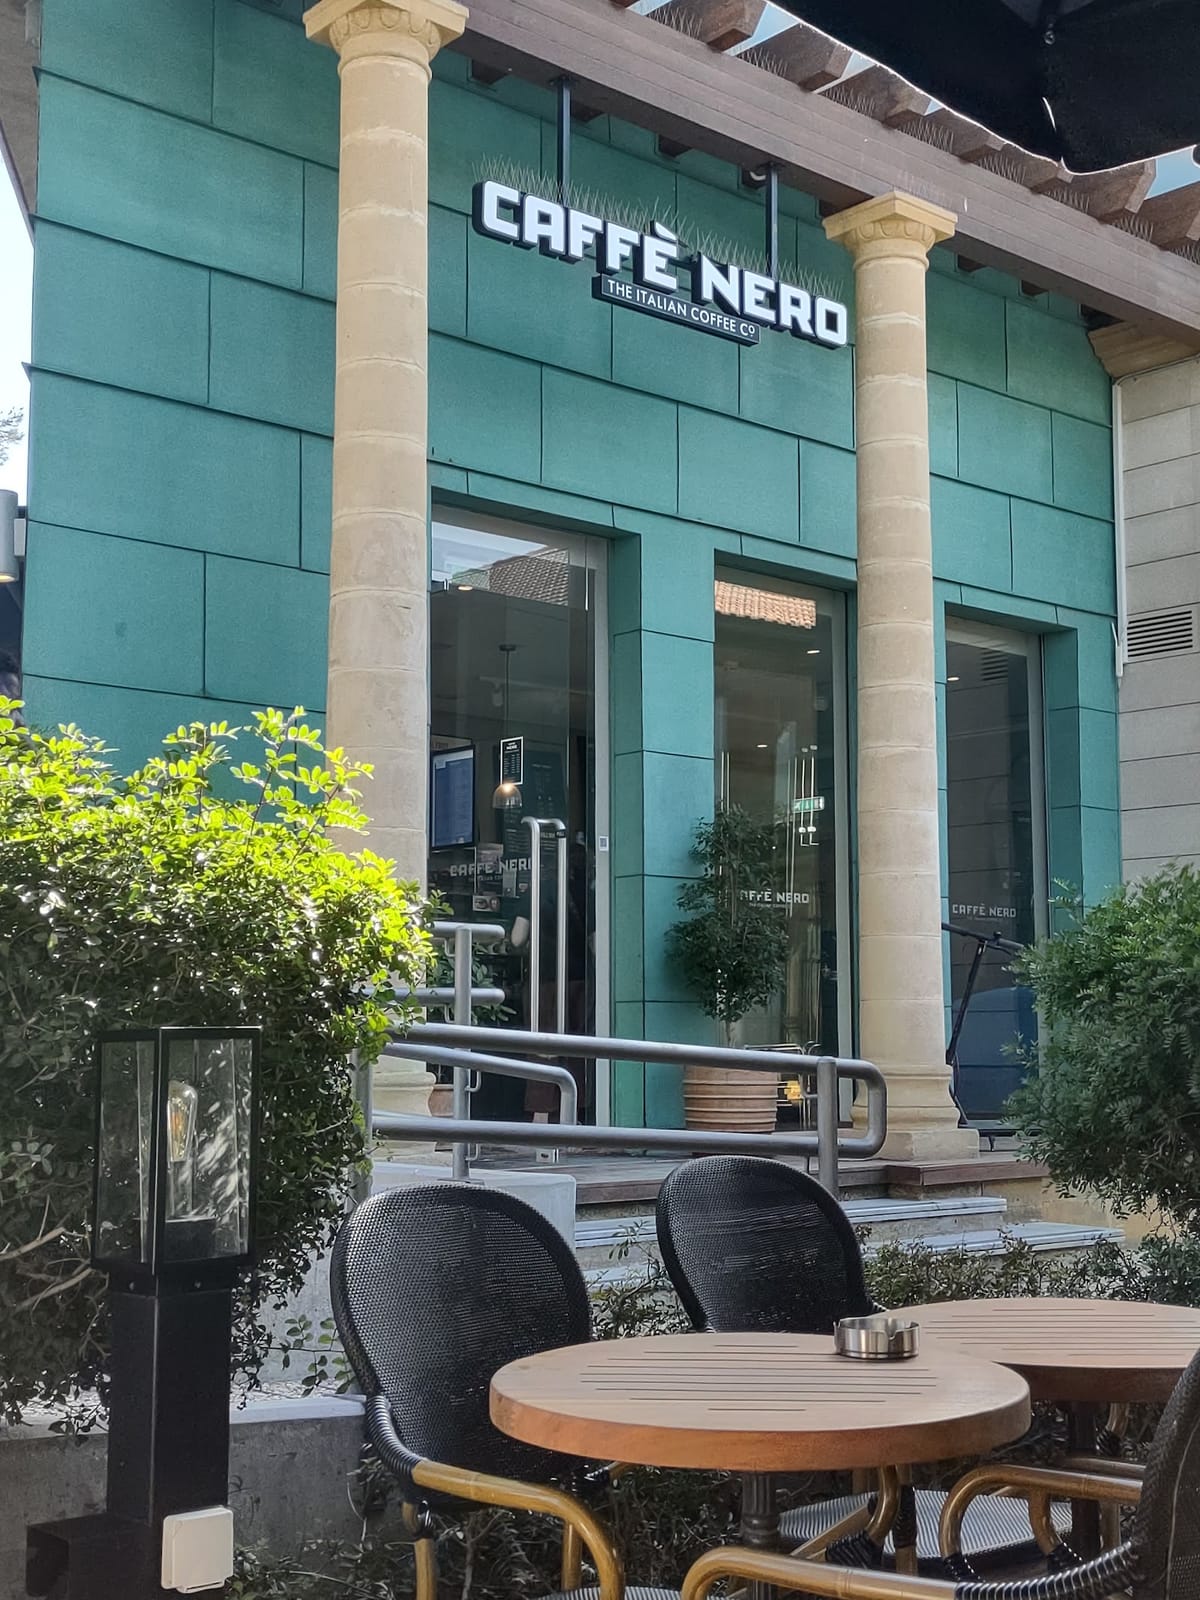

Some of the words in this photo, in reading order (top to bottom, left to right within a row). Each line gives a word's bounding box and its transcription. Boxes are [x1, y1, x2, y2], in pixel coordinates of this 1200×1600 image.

[481, 179, 679, 292] CAFFÈ
[698, 250, 849, 348] NERO
[607, 279, 633, 299] THE
[636, 288, 687, 317] ITALIAN
[690, 306, 737, 333] COFFEE
[776, 891, 810, 904] NERO
[989, 906, 1017, 918] NERO
